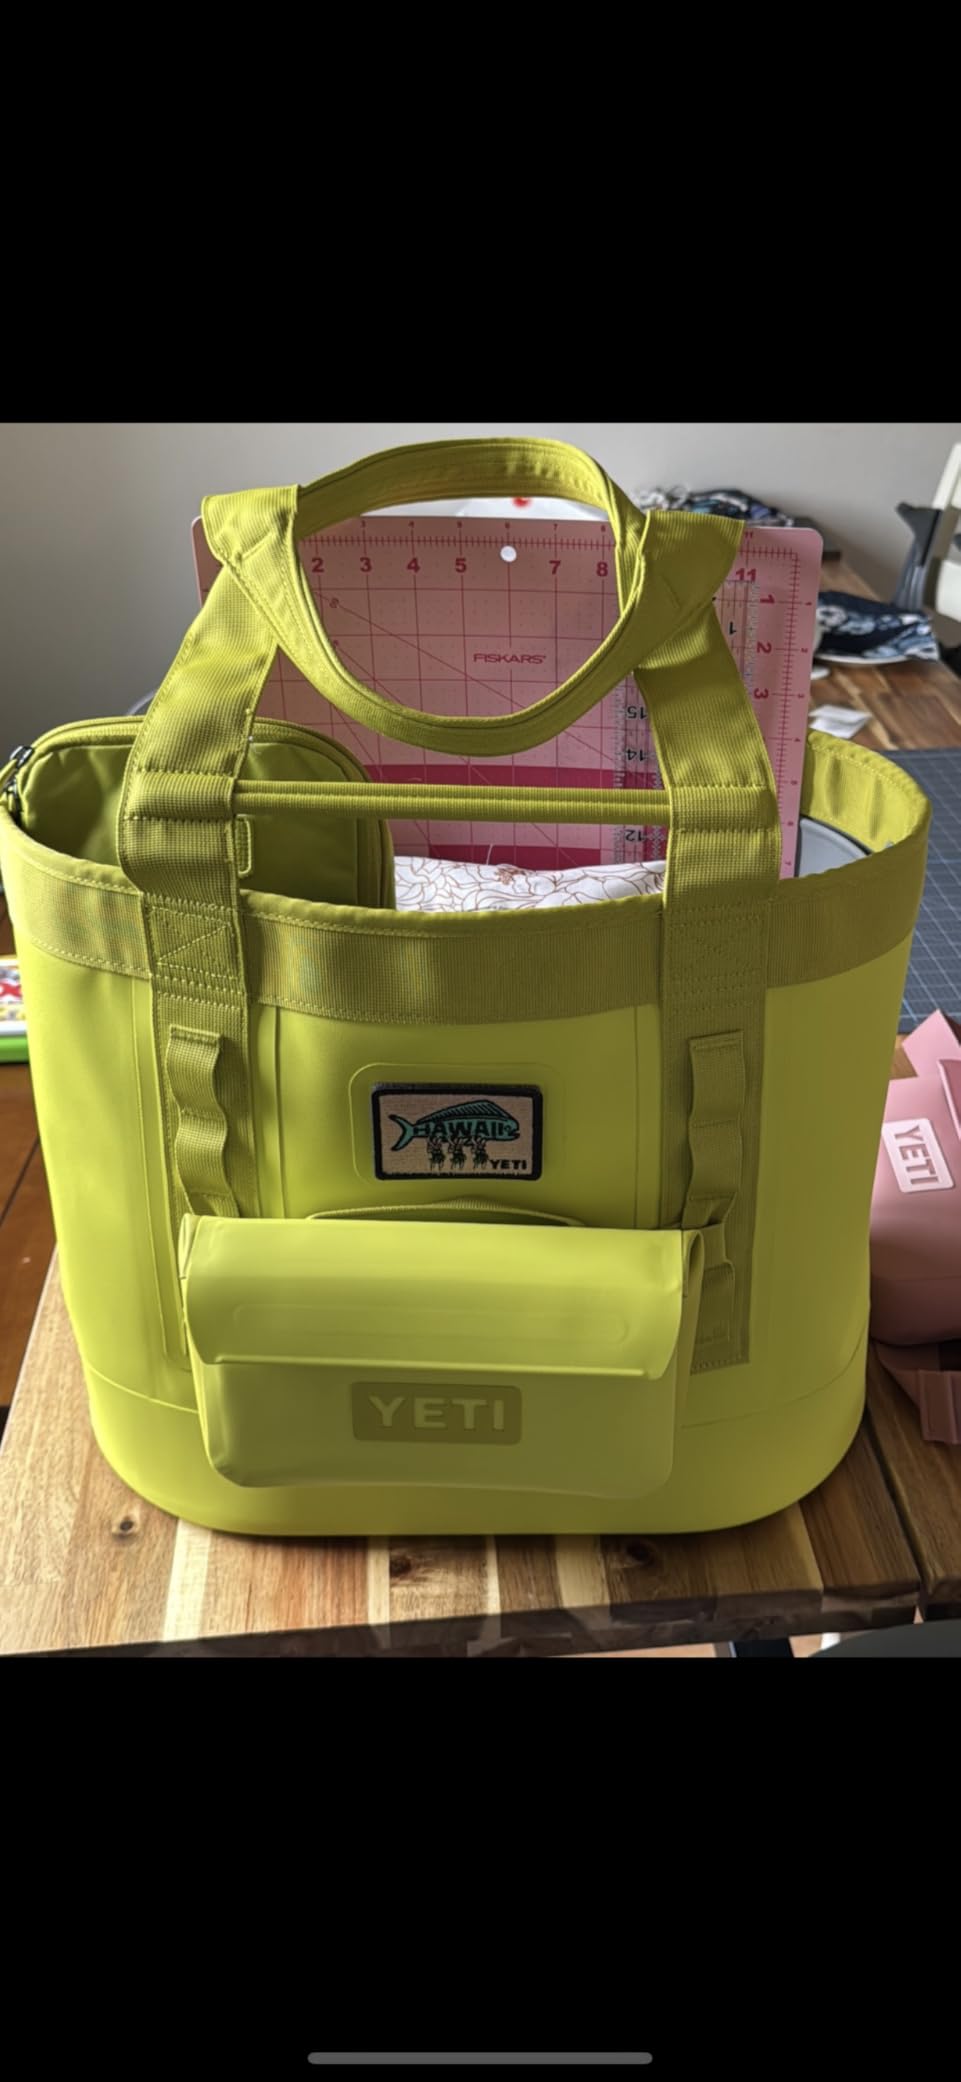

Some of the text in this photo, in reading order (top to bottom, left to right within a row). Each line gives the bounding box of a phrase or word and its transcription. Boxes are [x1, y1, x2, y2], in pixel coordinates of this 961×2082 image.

[311, 557, 757, 583] 2 3 4 5 7 8 11
[754, 594, 775, 700] 1 2 3
[626, 706, 648, 720] 15
[625, 748, 647, 762] 14
[625, 829, 646, 842] 12
[490, 1159, 527, 1170] YETI
[894, 1124, 940, 1185] YETI
[368, 1396, 504, 1430] YETI
